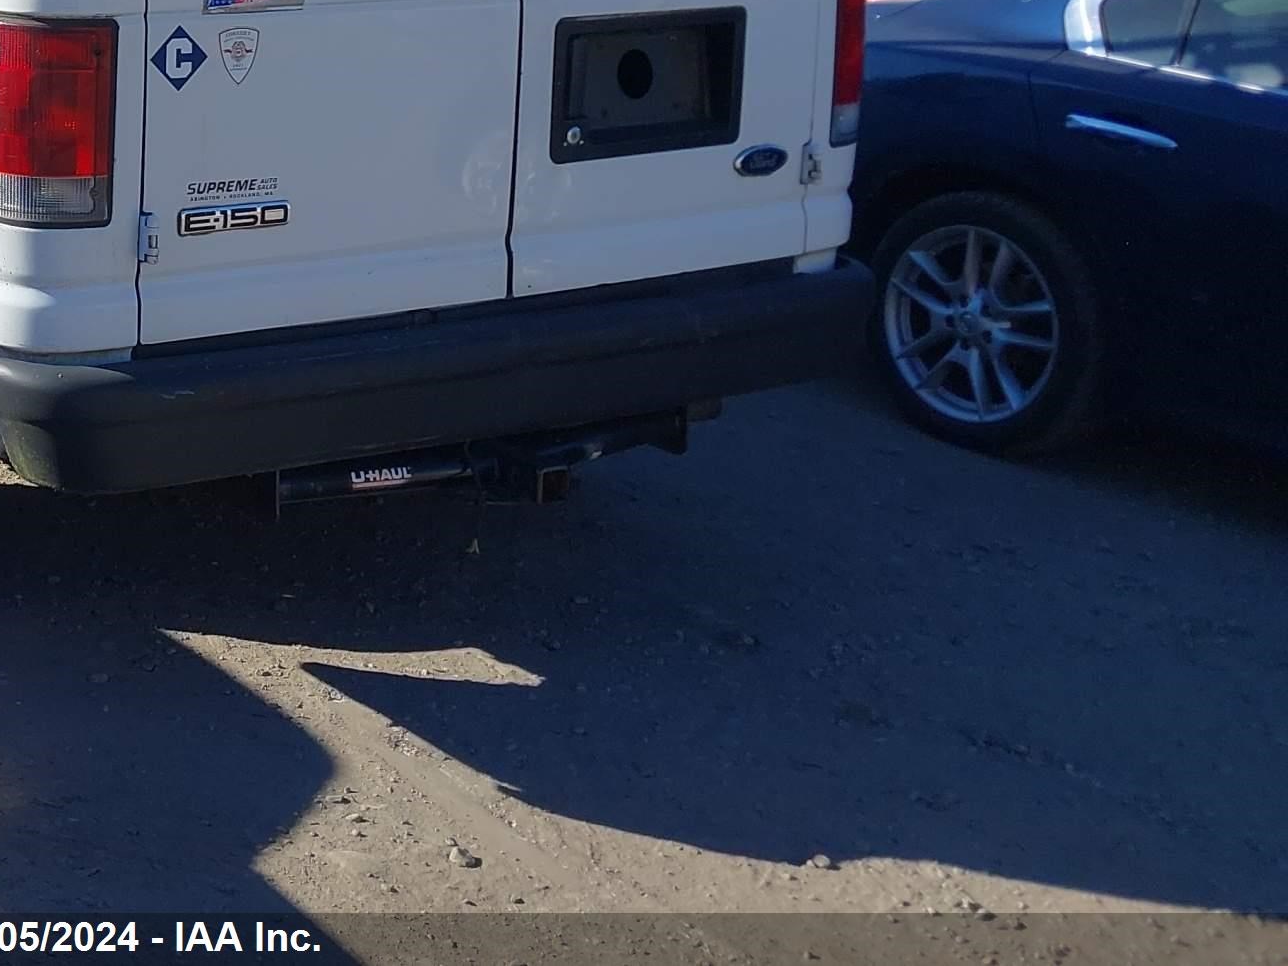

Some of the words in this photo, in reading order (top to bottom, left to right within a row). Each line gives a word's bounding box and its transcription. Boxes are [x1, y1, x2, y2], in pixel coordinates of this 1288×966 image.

[166, 38, 192, 79] C
[186, 179, 258, 195] SUPREME
[351, 467, 412, 483] U-HAUL
